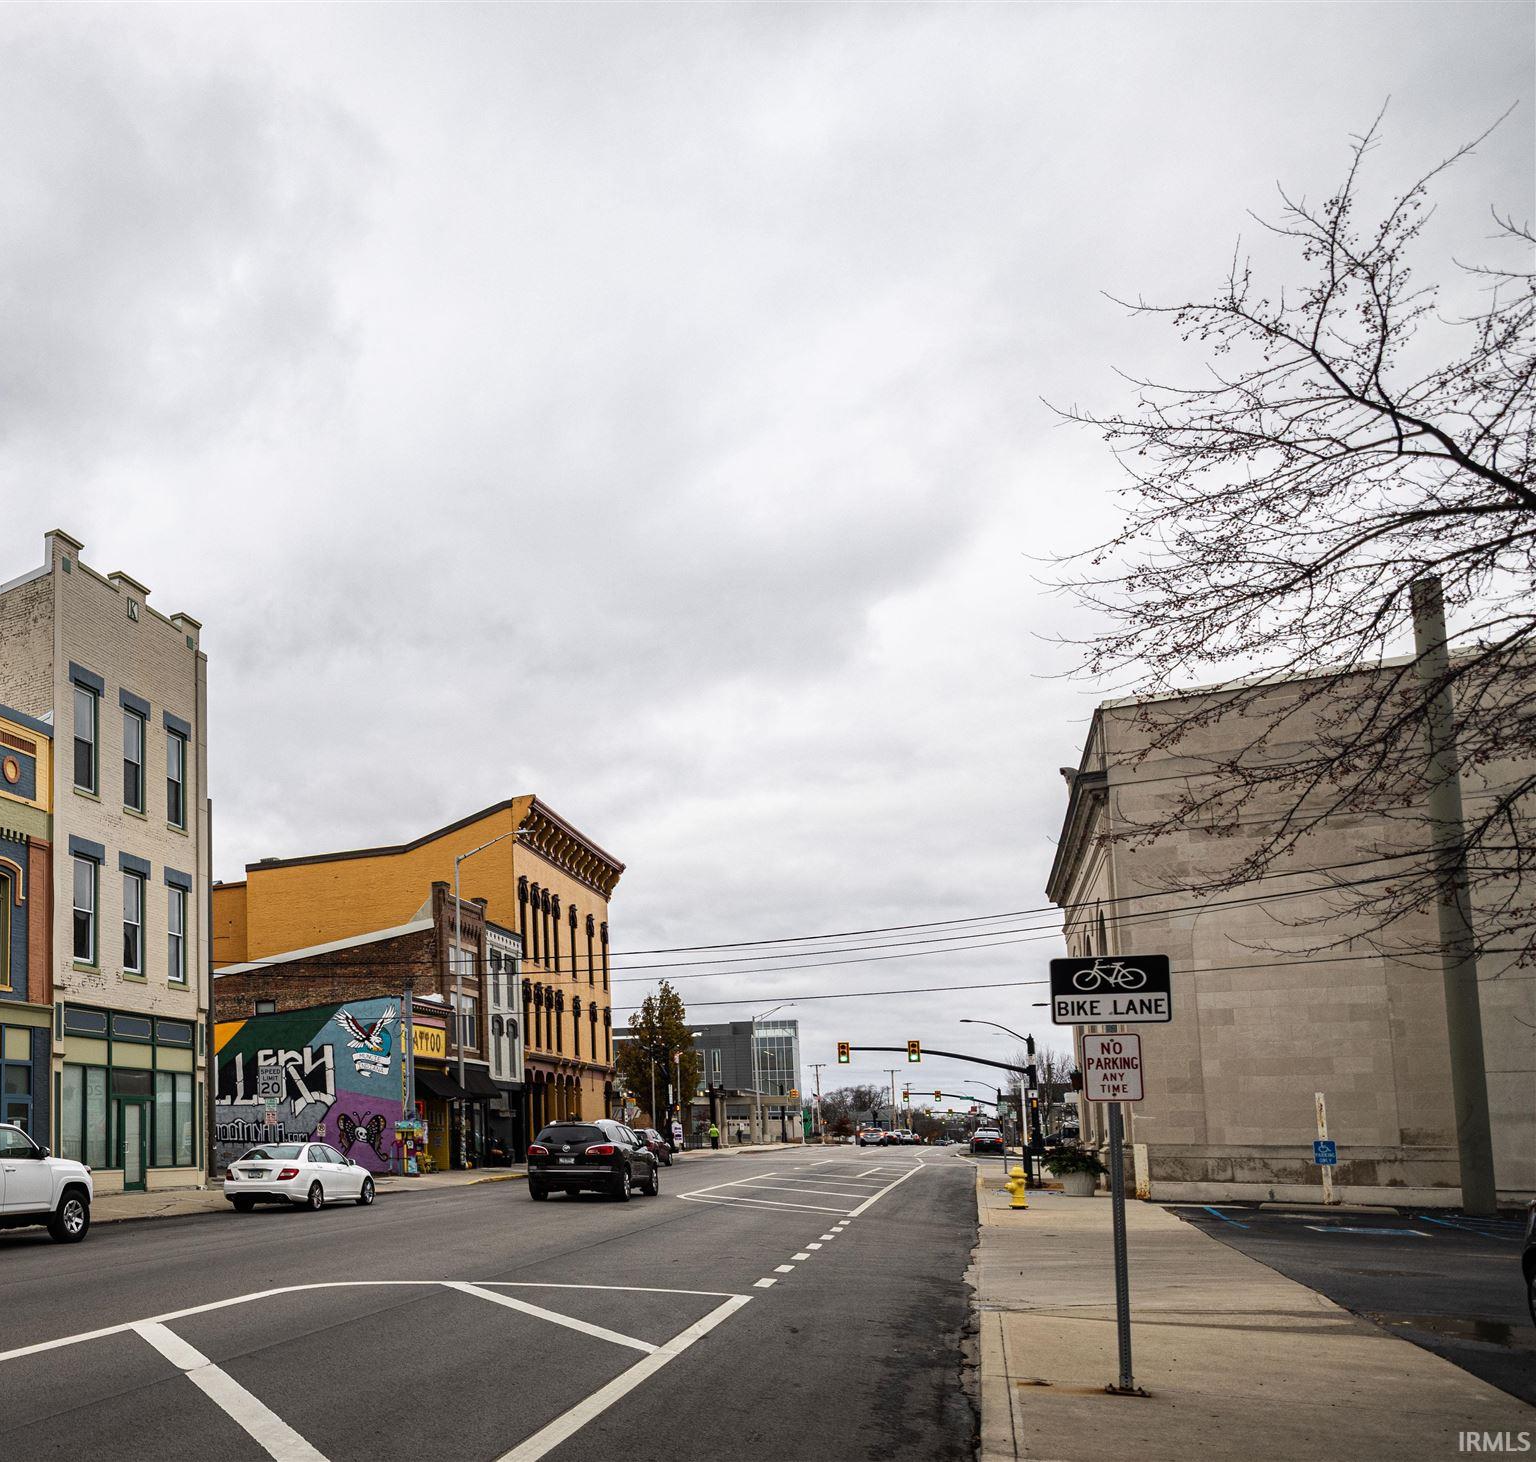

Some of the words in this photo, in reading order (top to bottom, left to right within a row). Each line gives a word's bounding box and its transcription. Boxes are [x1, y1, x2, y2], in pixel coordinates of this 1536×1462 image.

[1057, 1000, 1101, 1016] BIKE
[1113, 999, 1166, 1015] LANE
[1101, 1042, 1122, 1055] NO
[1087, 1057, 1139, 1070] PARKING
[1102, 1073, 1125, 1081] ANY
[261, 1082, 280, 1094] 20
[1100, 1085, 1128, 1093] TIME
